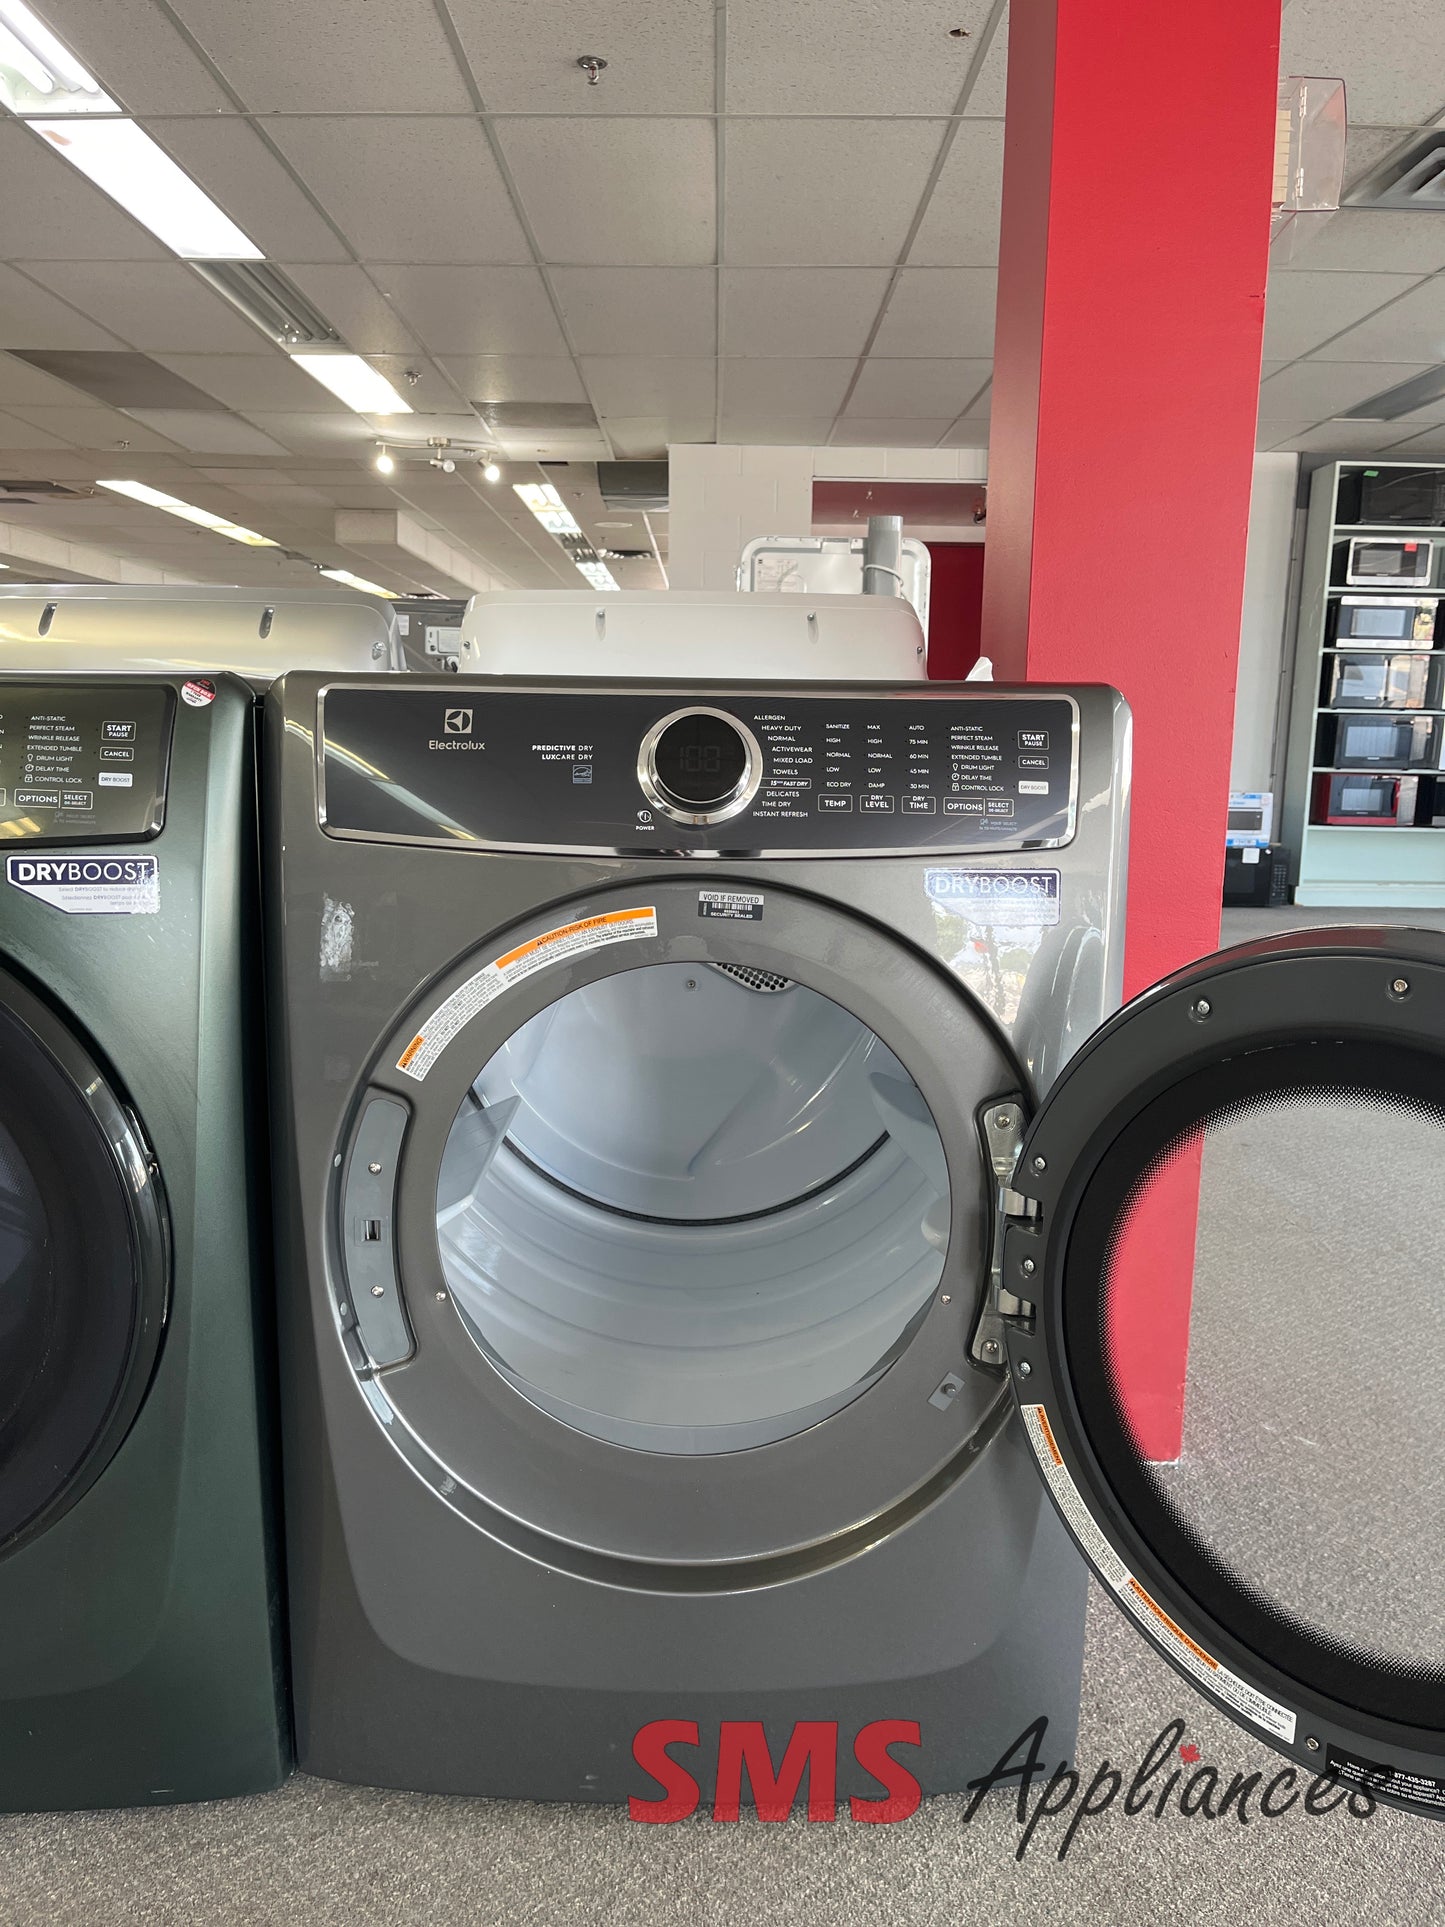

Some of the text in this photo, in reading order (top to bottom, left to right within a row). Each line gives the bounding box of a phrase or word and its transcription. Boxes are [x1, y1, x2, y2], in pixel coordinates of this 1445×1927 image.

[428, 739, 486, 751] Electrolux
[18, 795, 58, 803] OPTIONS
[909, 801, 929, 809] TIME
[18, 862, 149, 881] DRYBOOST
[935, 876, 1052, 894] DRYBOOST
[703, 893, 719, 901] VOID
[728, 895, 760, 904] REMOVED
[582, 920, 593, 928] OF
[592, 916, 607, 926] FIRE
[404, 1037, 422, 1064] WARNING
[1040, 1414, 1062, 1465] AVERTISSEMENT
